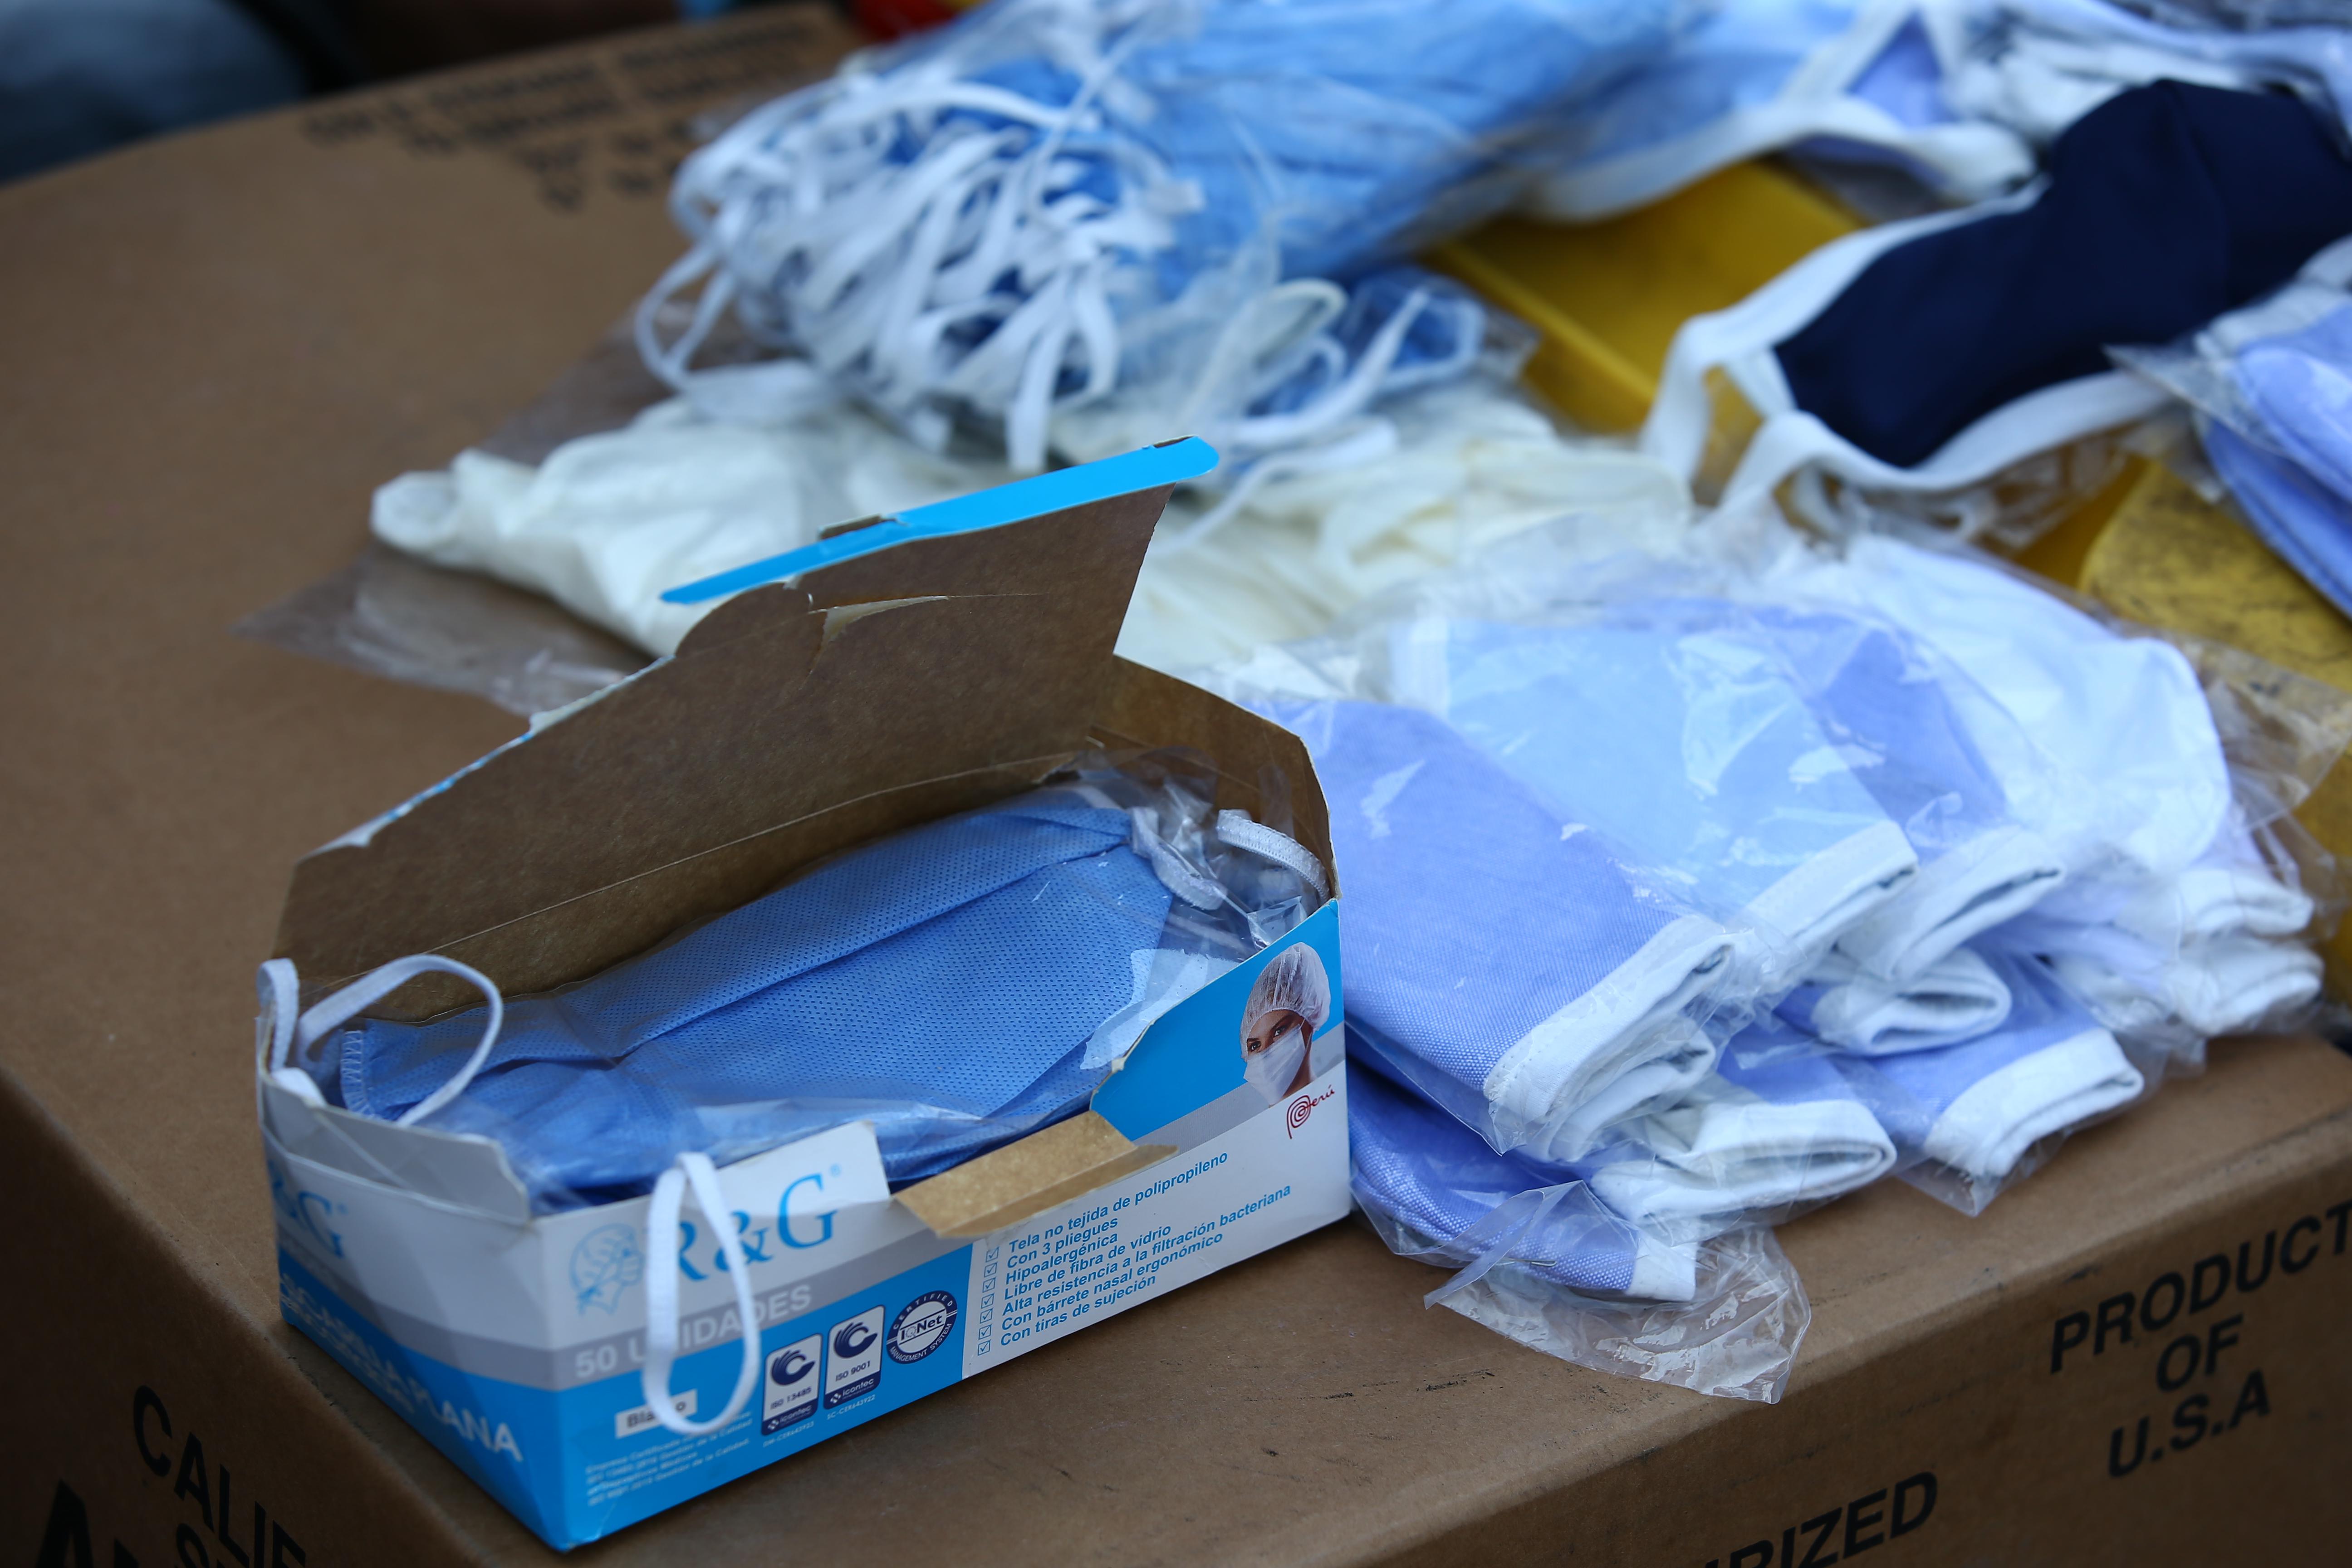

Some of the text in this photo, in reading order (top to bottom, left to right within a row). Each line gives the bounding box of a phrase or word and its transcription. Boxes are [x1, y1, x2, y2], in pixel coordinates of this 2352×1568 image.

[1009, 1153, 1228, 1253] Tela no tejida de polipropileno
[1003, 1185, 1290, 1316] Alta resistencia a la filtración bacteriana
[1004, 1226, 1171, 1300] Libre de fibra de vidrio
[1005, 1233, 1117, 1284] Hipoalergénica
[1007, 1218, 1118, 1268] Con 3 pliegues
[893, 1293, 953, 1330] CERTIFIED
[1000, 1275, 1156, 1346] Con tiras de sujeción
[1002, 1233, 1223, 1331] Con bárrete nasal ergonómico
[2050, 1200, 2352, 1374] PRODUCT
[575, 1284, 811, 1378] 50 UIDADES
[890, 1323, 952, 1362] MANAGEMENT SYSTEM
[2157, 1313, 2244, 1393] OF
[836, 1361, 871, 1382] ISO 9001
[843, 1378, 874, 1396] icontec
[2108, 1368, 2271, 1478] U.S.A
